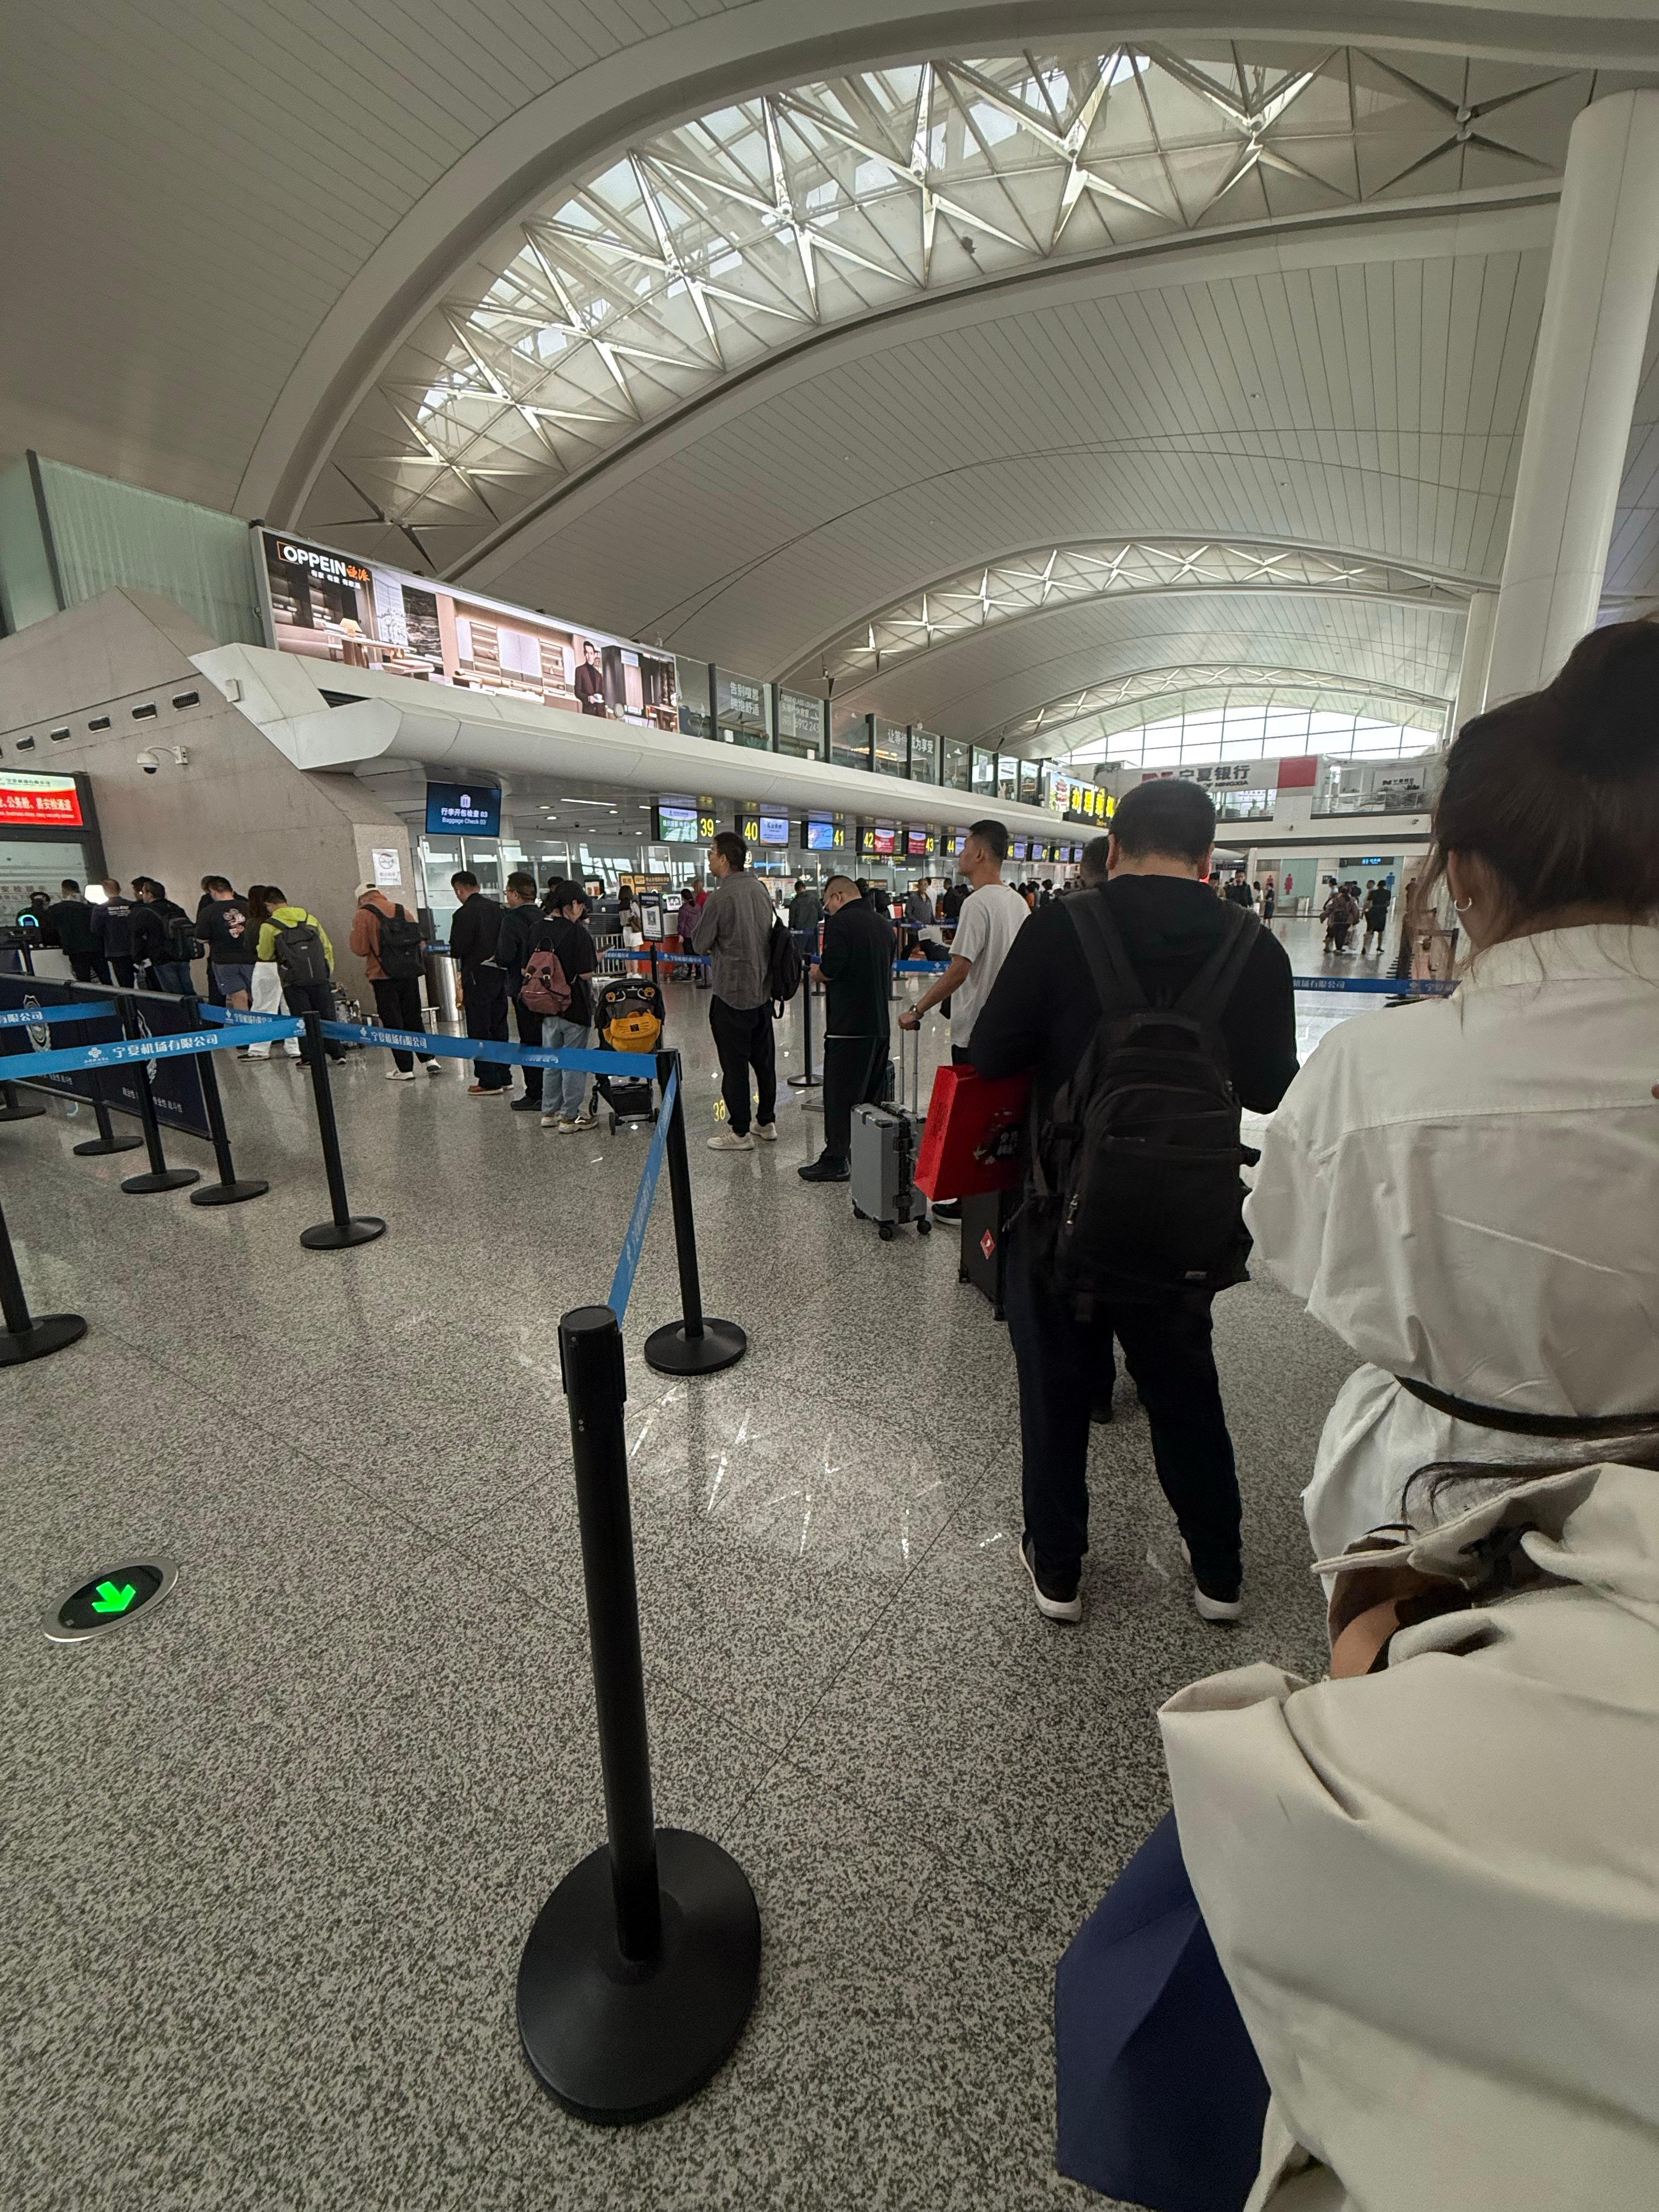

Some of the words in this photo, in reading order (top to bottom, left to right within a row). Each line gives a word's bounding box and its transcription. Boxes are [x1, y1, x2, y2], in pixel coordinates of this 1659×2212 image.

[283, 545, 347, 577] OPPEIN
[1180, 765, 1250, 782] 宁夏银行
[441, 808, 479, 817] 行李开包检查
[700, 818, 714, 837] 39
[744, 821, 758, 841] 40
[833, 830, 844, 846] 41
[864, 832, 873, 848] 42
[926, 838, 934, 852] 43
[947, 839, 955, 853] 44
[112, 1034, 218, 1058] 宁夏机场有限公司
[371, 1031, 427, 1048] 宁夏机场有限公司
